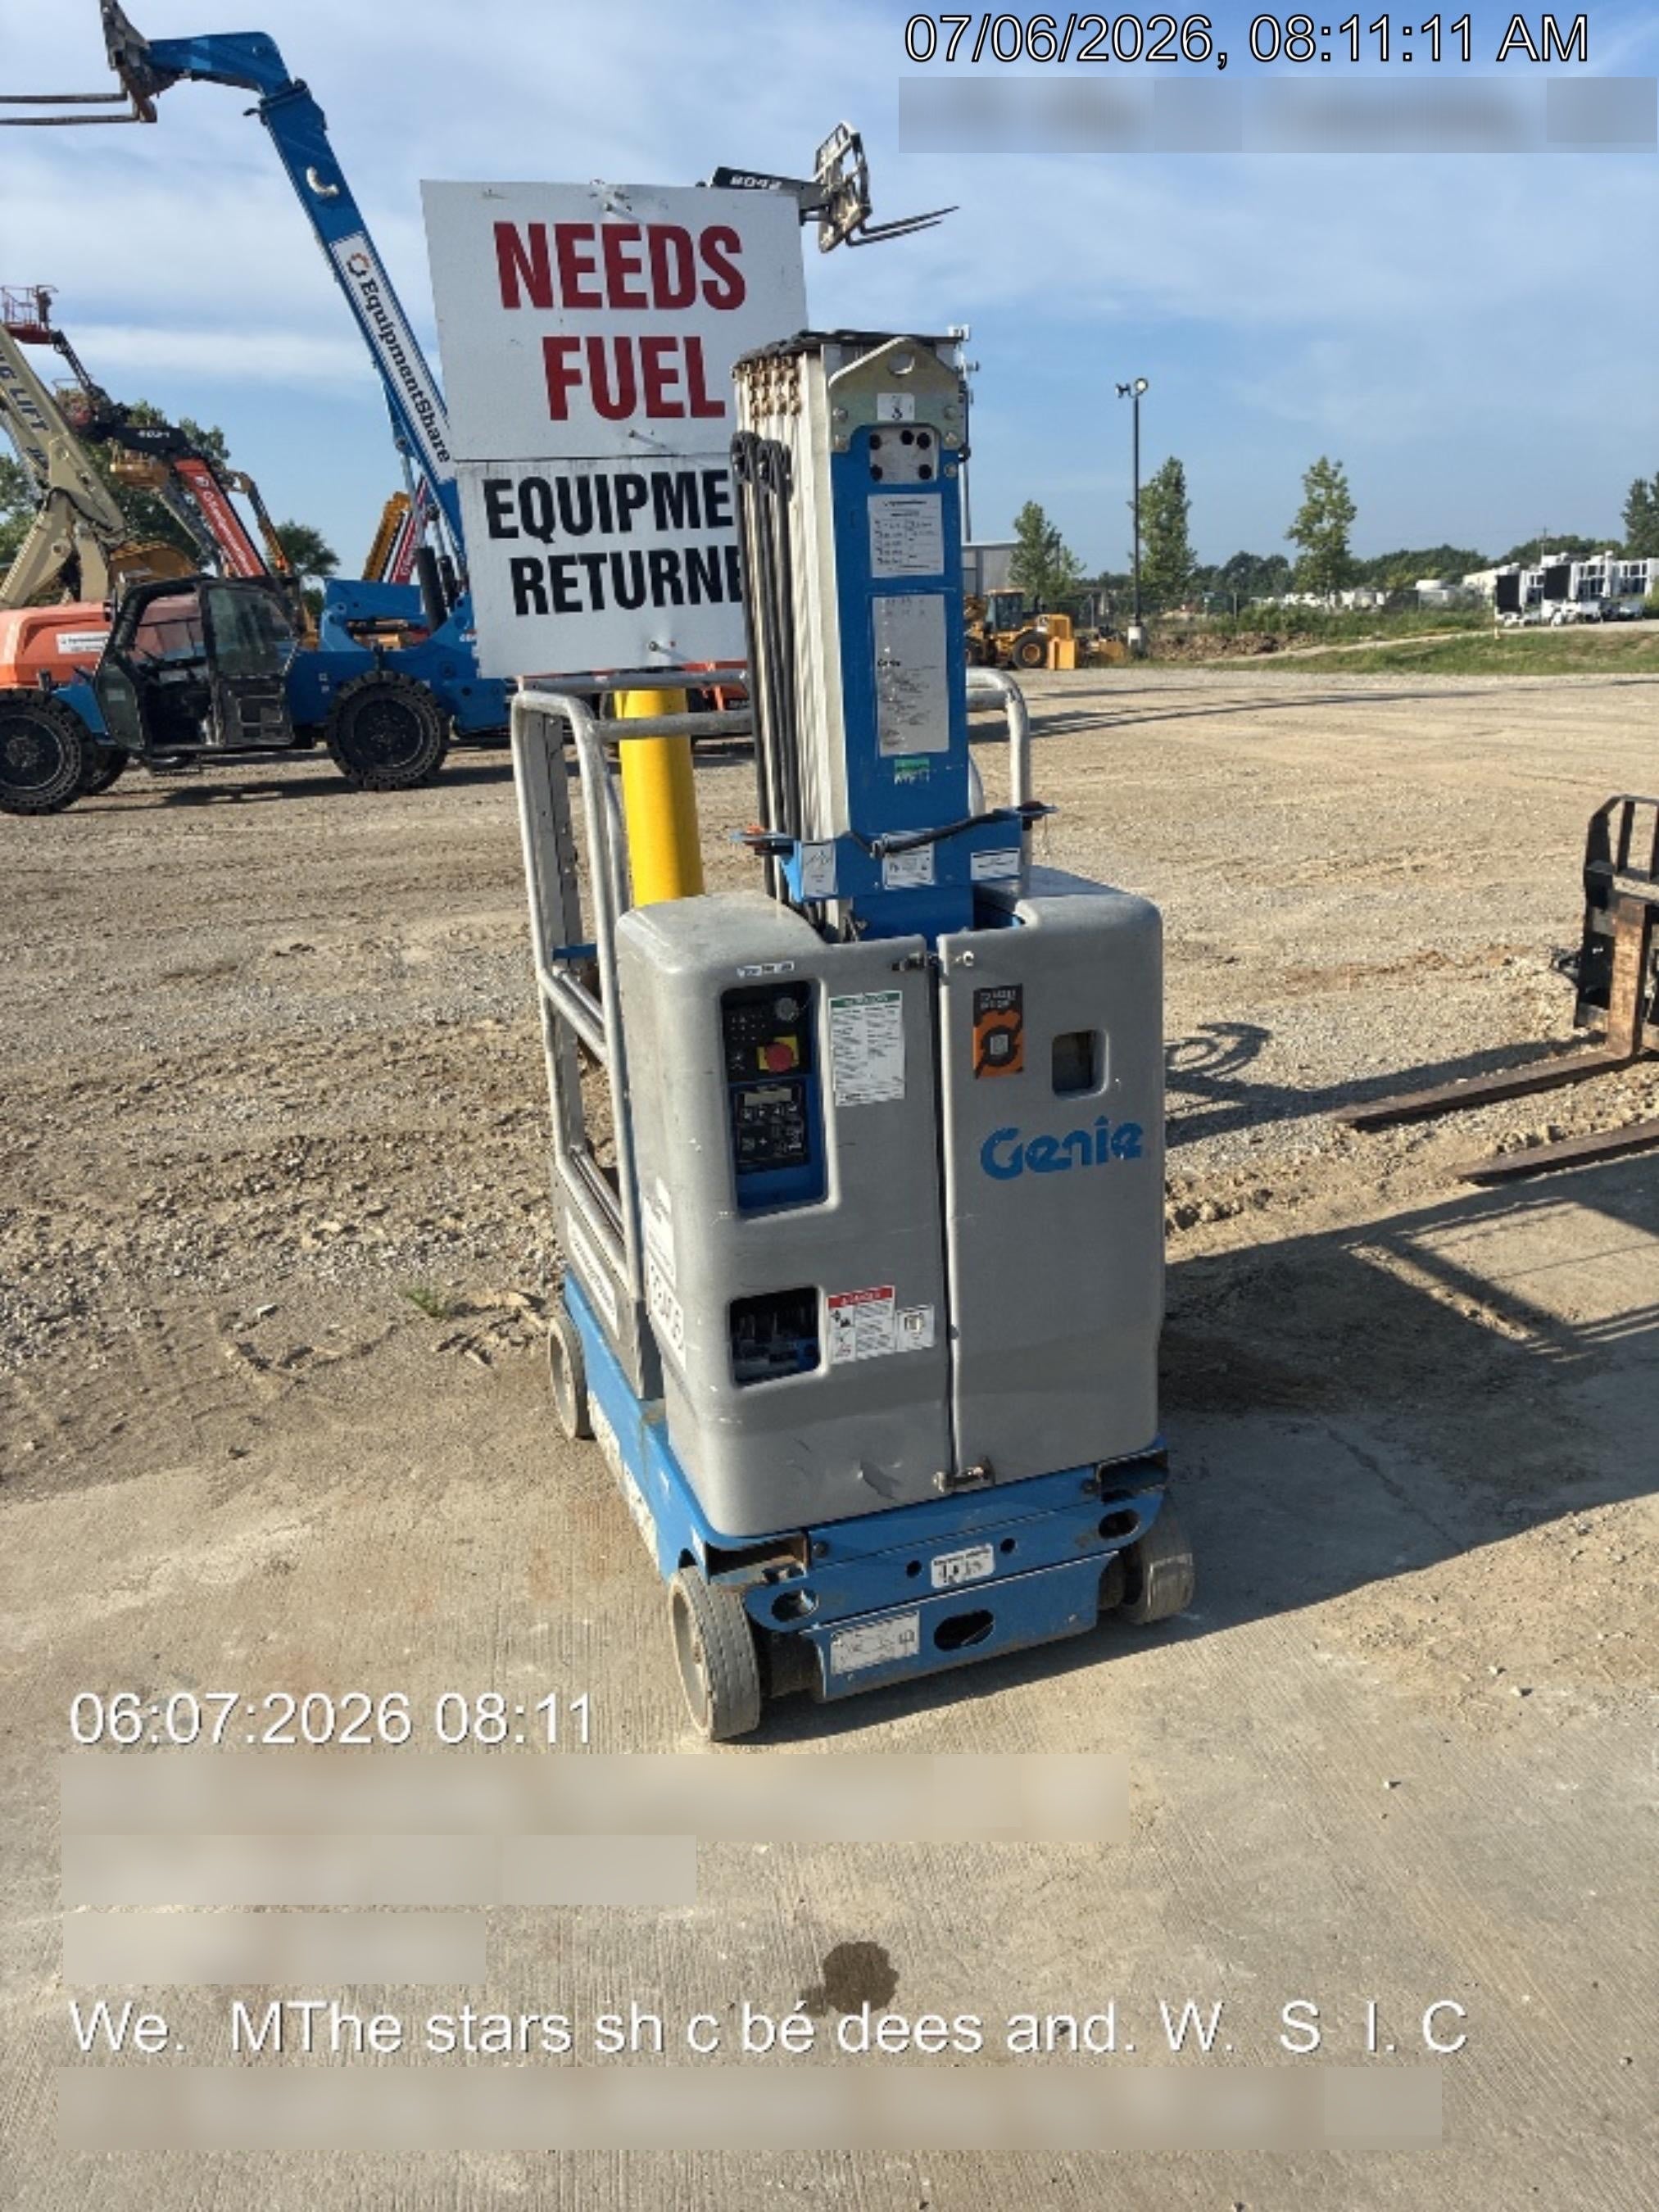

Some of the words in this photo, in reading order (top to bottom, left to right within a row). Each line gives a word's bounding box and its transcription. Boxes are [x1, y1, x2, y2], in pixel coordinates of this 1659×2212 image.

[493, 221, 746, 310] NEEDS
[359, 277, 451, 463] EquipmentShare
[542, 336, 726, 420] FUEL
[482, 469, 734, 544] EQUIPME
[510, 545, 743, 616] RETURNE
[980, 1115, 1144, 1181] Genie
